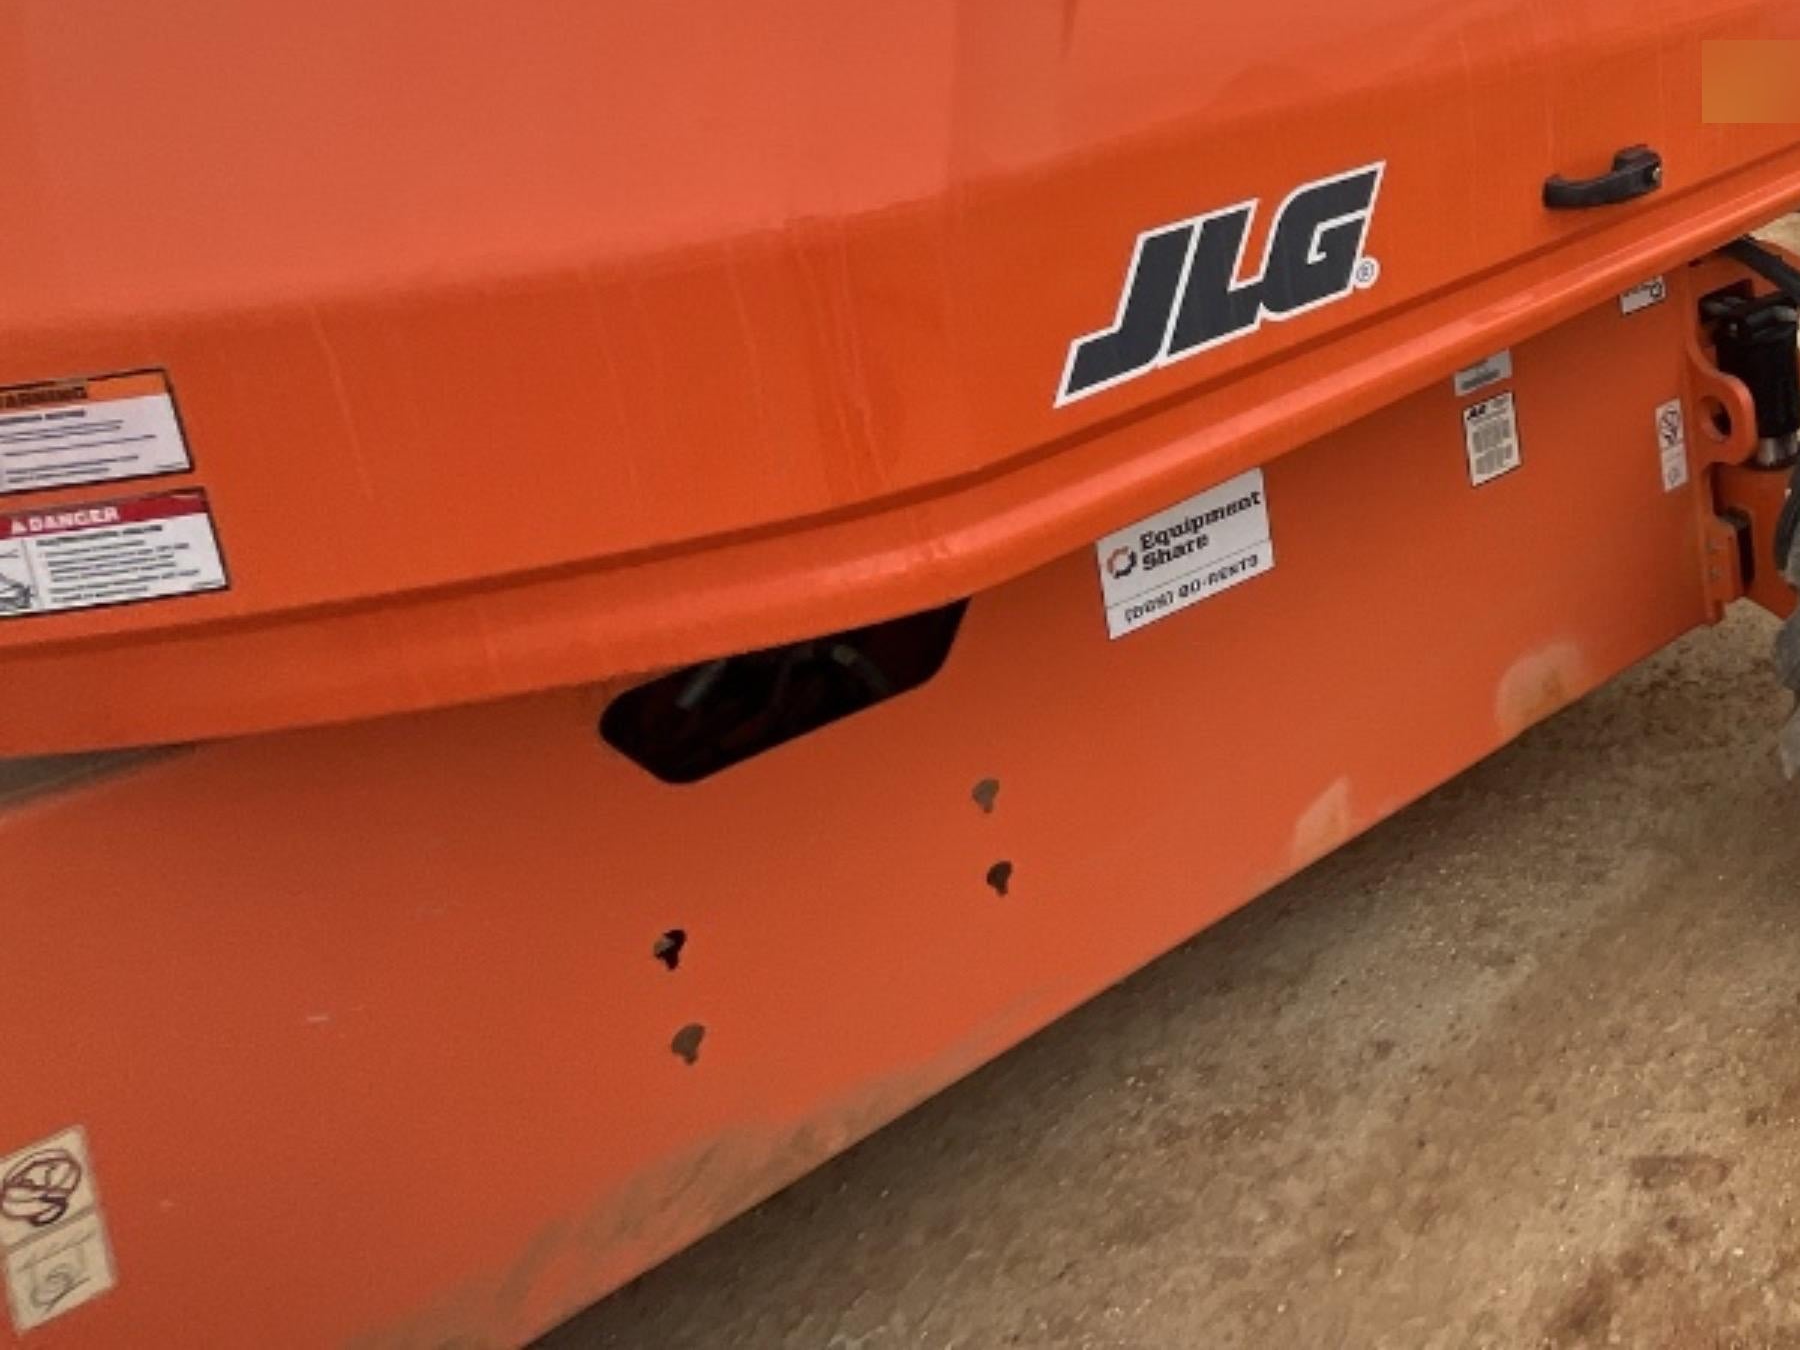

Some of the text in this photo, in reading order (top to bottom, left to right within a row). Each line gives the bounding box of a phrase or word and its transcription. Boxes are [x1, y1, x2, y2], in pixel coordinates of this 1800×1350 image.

[1053, 159, 1386, 409] JLG
[29, 506, 121, 533] DANGER
[1139, 490, 1261, 551] Equipment
[1141, 533, 1210, 572] Share
